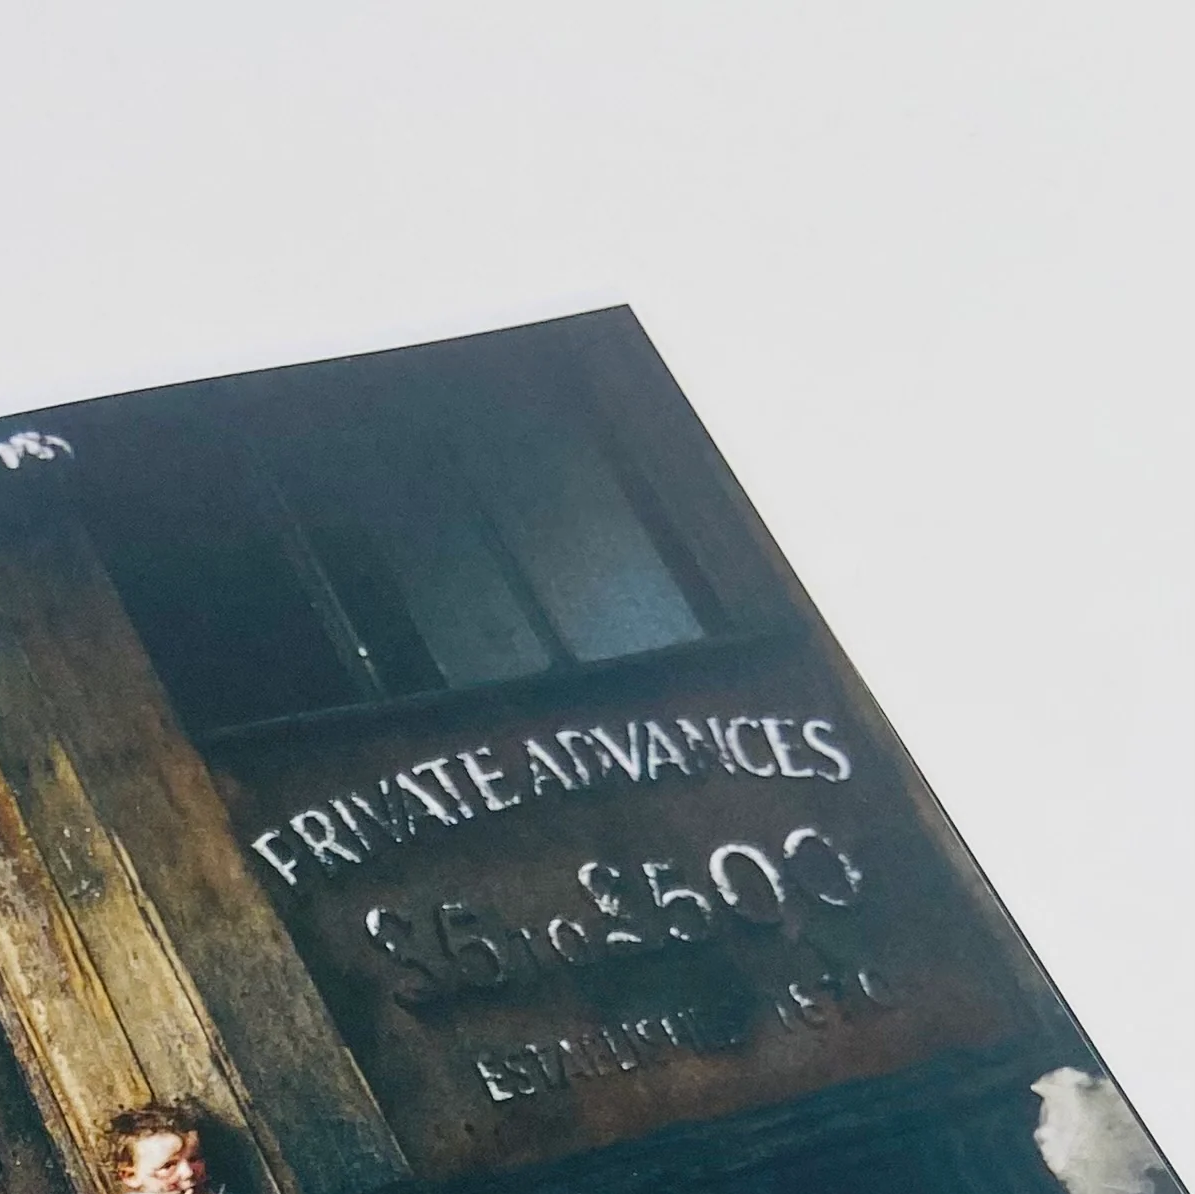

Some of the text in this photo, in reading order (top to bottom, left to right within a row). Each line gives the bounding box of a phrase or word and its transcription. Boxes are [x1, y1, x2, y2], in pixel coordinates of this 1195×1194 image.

[251, 715, 852, 886] PRIVATE ADVANCES
[577, 826, 863, 945] £500
